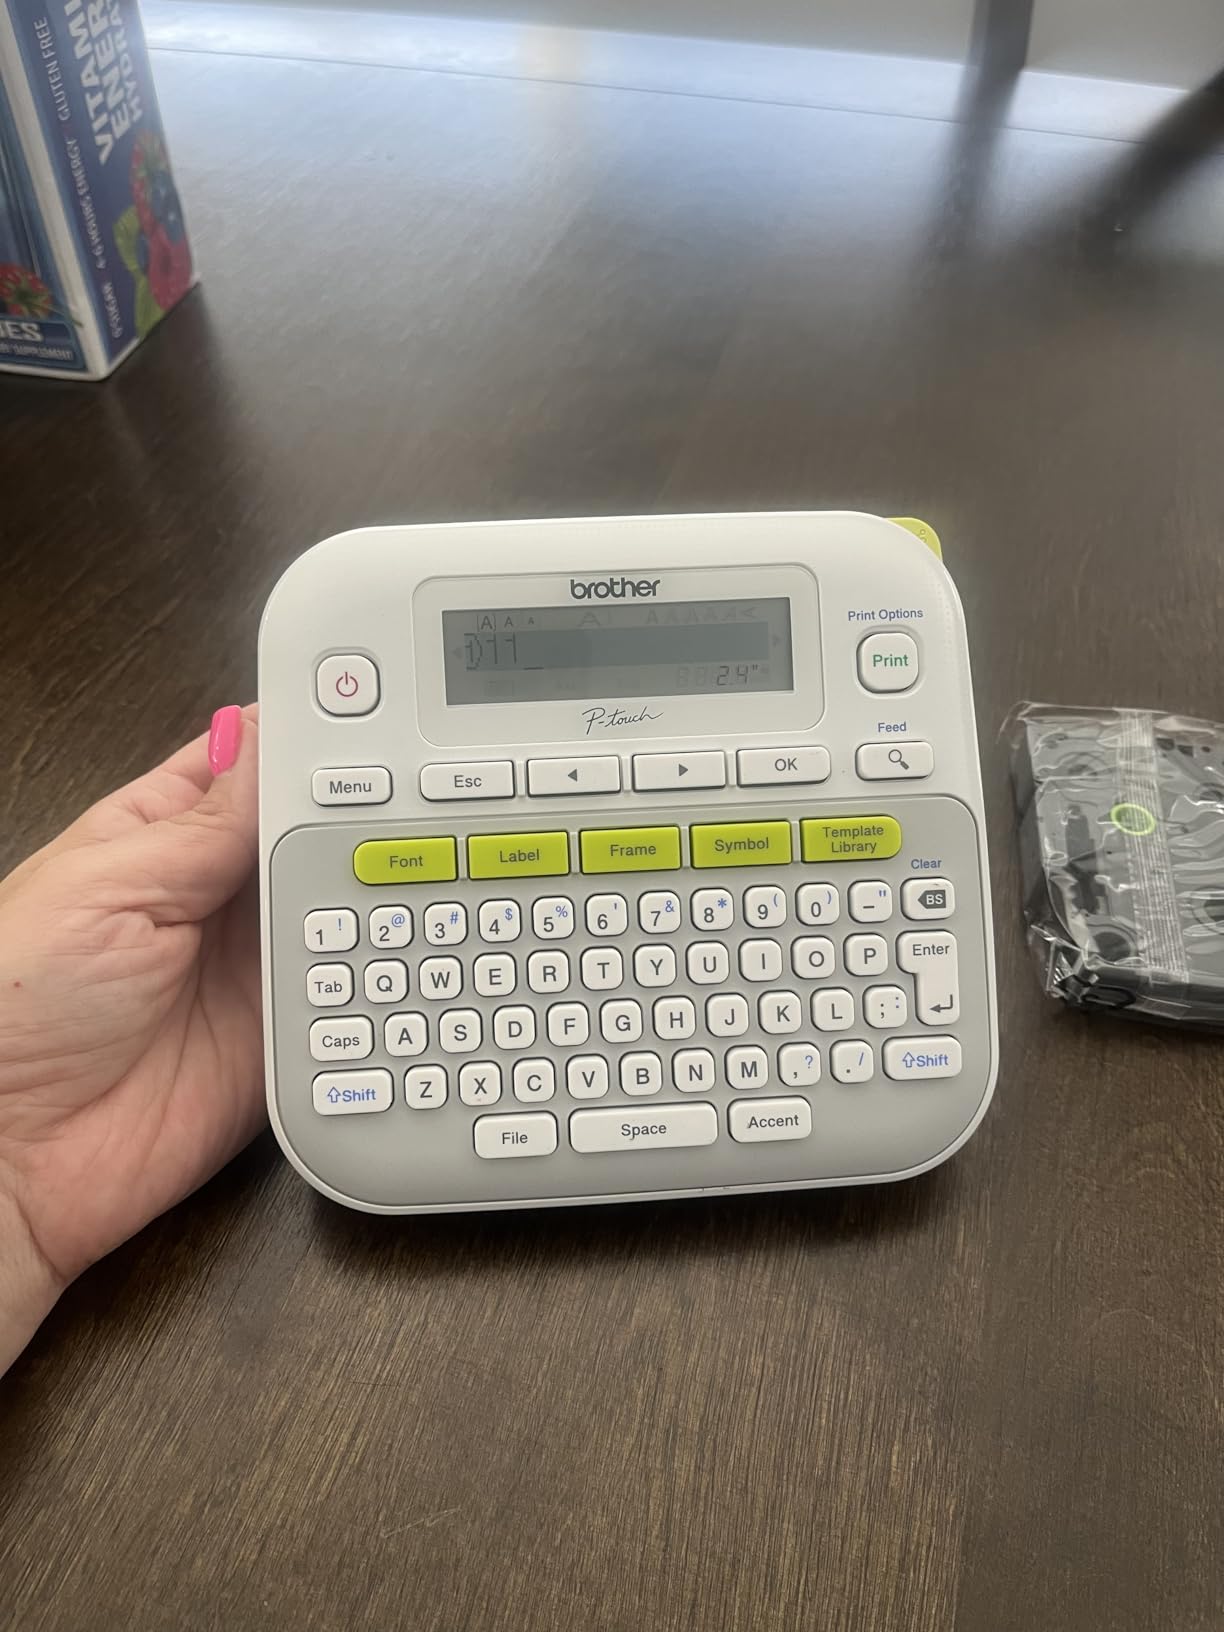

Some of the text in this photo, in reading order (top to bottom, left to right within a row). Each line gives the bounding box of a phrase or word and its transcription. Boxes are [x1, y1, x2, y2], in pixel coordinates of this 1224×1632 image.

[34, 16, 71, 121] GLUTEN FREE
[0, 320, 43, 342] ES
[570, 577, 661, 600] brother
[847, 608, 924, 622] Print Options
[872, 653, 909, 668] Print
[581, 705, 664, 736] P-touch
[877, 721, 907, 733] Feed
[774, 757, 798, 772] OK
[329, 780, 372, 795] Menu
[453, 774, 482, 789] Esc
[822, 824, 884, 840] Template
[608, 844, 657, 857] Frame
[714, 836, 769, 855] Symbol
[831, 840, 877, 855] Library
[389, 855, 424, 869] Font
[498, 848, 540, 864] Label
[910, 858, 942, 870] Clear
[926, 893, 944, 907] BS
[808, 950, 825, 968] O
[863, 947, 877, 965] P
[912, 943, 950, 957] Enter
[649, 958, 664, 976] Y
[702, 955, 717, 974] U
[761, 952, 766, 970] I
[488, 967, 503, 986] E
[542, 965, 557, 983] R
[596, 961, 611, 980] T
[313, 980, 343, 994] Tab
[376, 974, 393, 993] Q
[430, 971, 451, 989] W
[669, 1011, 684, 1029] H
[724, 1008, 735, 1026] J
[776, 1004, 791, 1023] K
[831, 1002, 844, 1020] L
[507, 1020, 523, 1039] D
[563, 1017, 576, 1036] F
[615, 1014, 631, 1032] G
[397, 1027, 413, 1046] A
[453, 1023, 468, 1042] S
[321, 1035, 360, 1050] Caps
[740, 1060, 758, 1079] M
[915, 1053, 949, 1068] Shift
[581, 1070, 596, 1088] V
[635, 1067, 650, 1085] B
[688, 1063, 703, 1082] N
[419, 1080, 433, 1099] Z
[473, 1077, 488, 1095] X
[526, 1074, 542, 1092] C
[342, 1088, 377, 1103] Shift
[620, 1121, 668, 1139] Space
[747, 1114, 799, 1129] Accent
[501, 1131, 528, 1145] File
